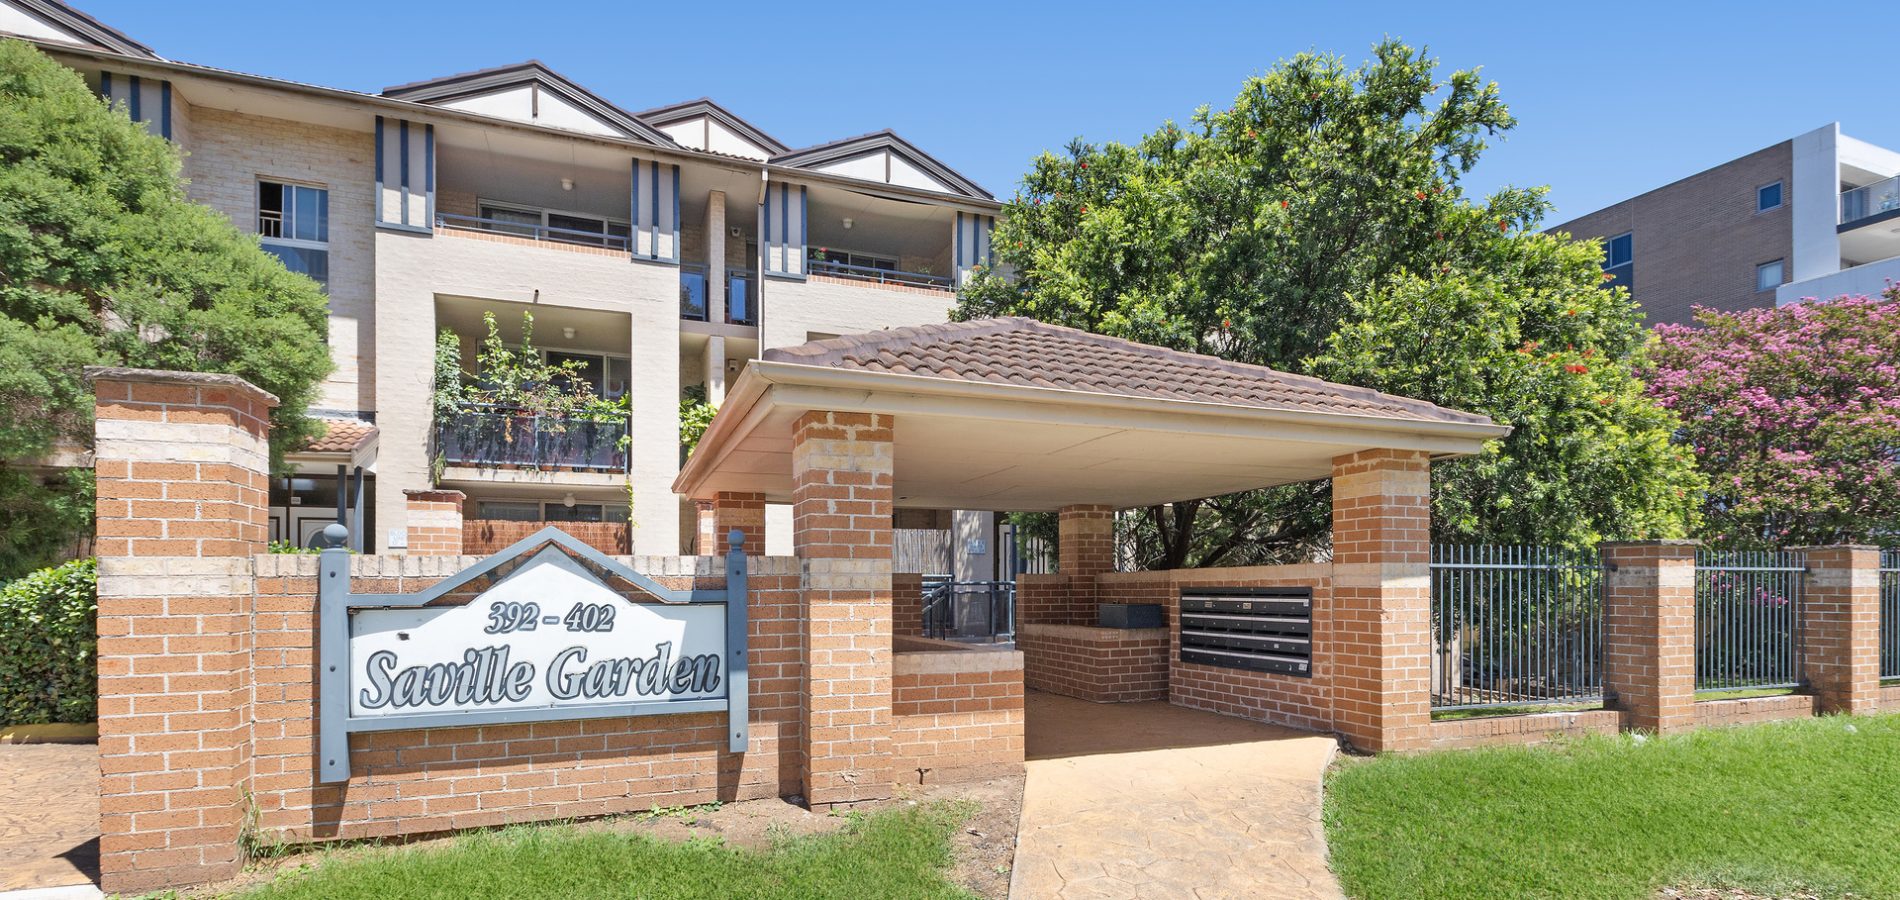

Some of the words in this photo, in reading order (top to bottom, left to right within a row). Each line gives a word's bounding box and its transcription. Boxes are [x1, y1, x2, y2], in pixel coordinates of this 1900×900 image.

[484, 601, 540, 634] 392
[563, 602, 616, 632] 402
[360, 644, 535, 709] Saville
[546, 641, 721, 700] Garden
